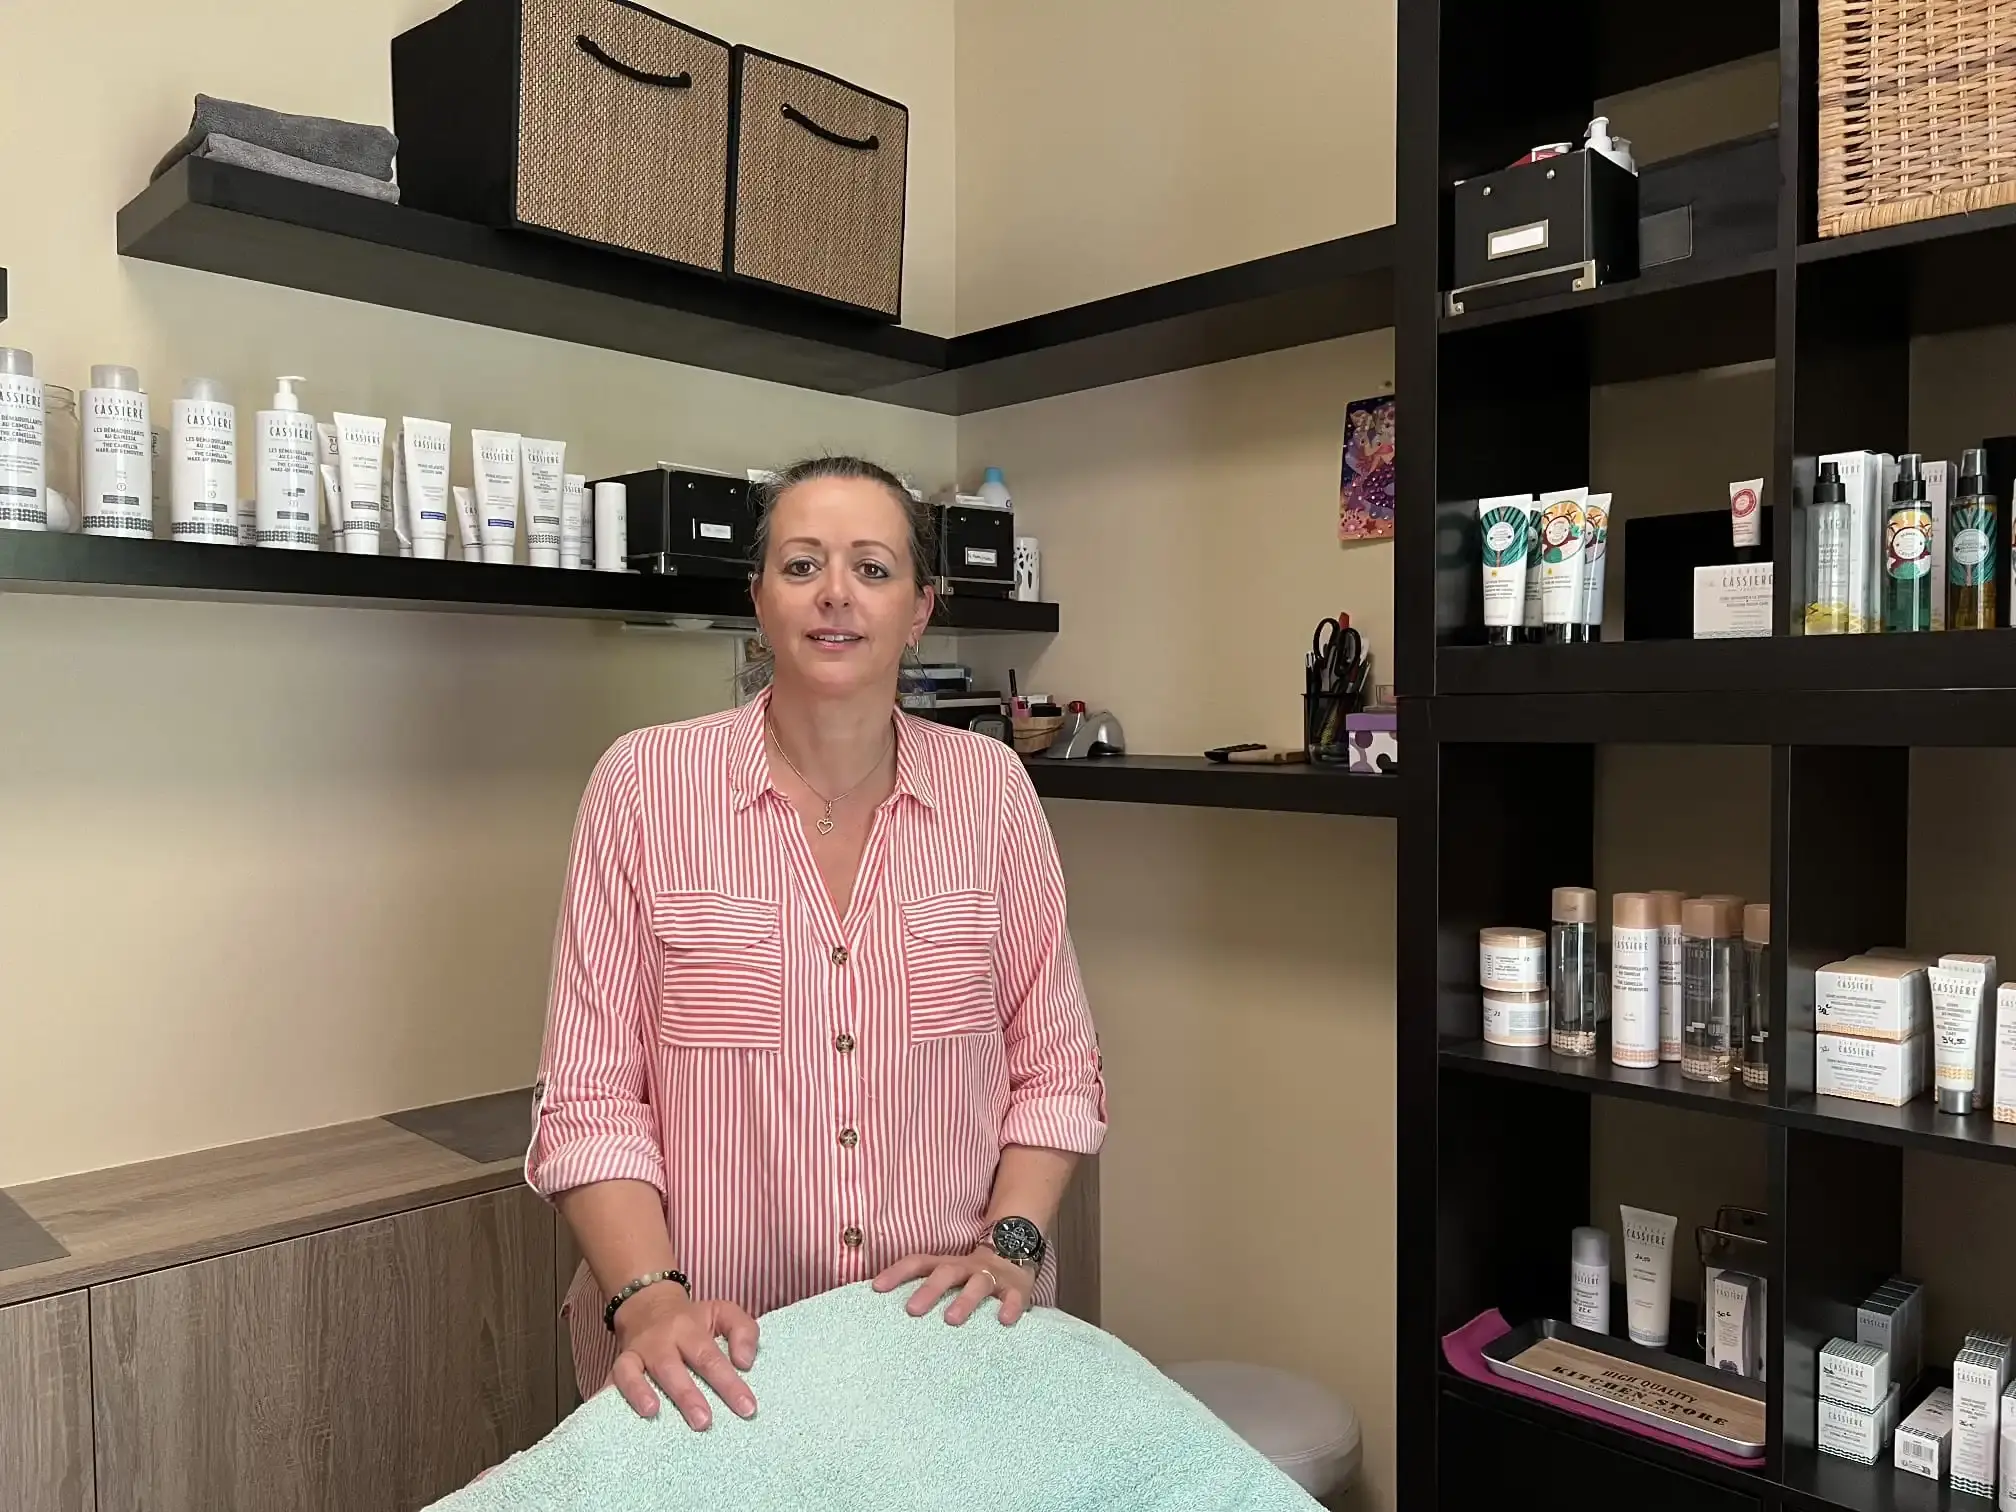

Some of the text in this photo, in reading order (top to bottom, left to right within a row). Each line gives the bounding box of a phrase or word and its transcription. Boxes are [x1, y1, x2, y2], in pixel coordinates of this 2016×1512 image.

[0, 391, 41, 408] ASSIERE
[94, 404, 144, 420] CASSIERE
[187, 414, 232, 430] CASSIERE
[269, 426, 313, 441] CASSIERE
[345, 431, 380, 446] CASSIERE
[481, 451, 514, 462] CASSIERE
[1722, 574, 1773, 588] CASSIERE
[1837, 980, 1874, 992] CASSIERE
[1932, 982, 1977, 997] CASSIERE
[1838, 1045, 1876, 1058] CASSIERE
[1626, 1228, 1665, 1247] CASSIERE
[1828, 1361, 1864, 1378] CASSIERE
[1602, 1370, 1639, 1383] HIGH
[1640, 1380, 1699, 1405] QUALITY
[1551, 1366, 1648, 1400] KITCHEN
[1655, 1399, 1729, 1427] STORE
